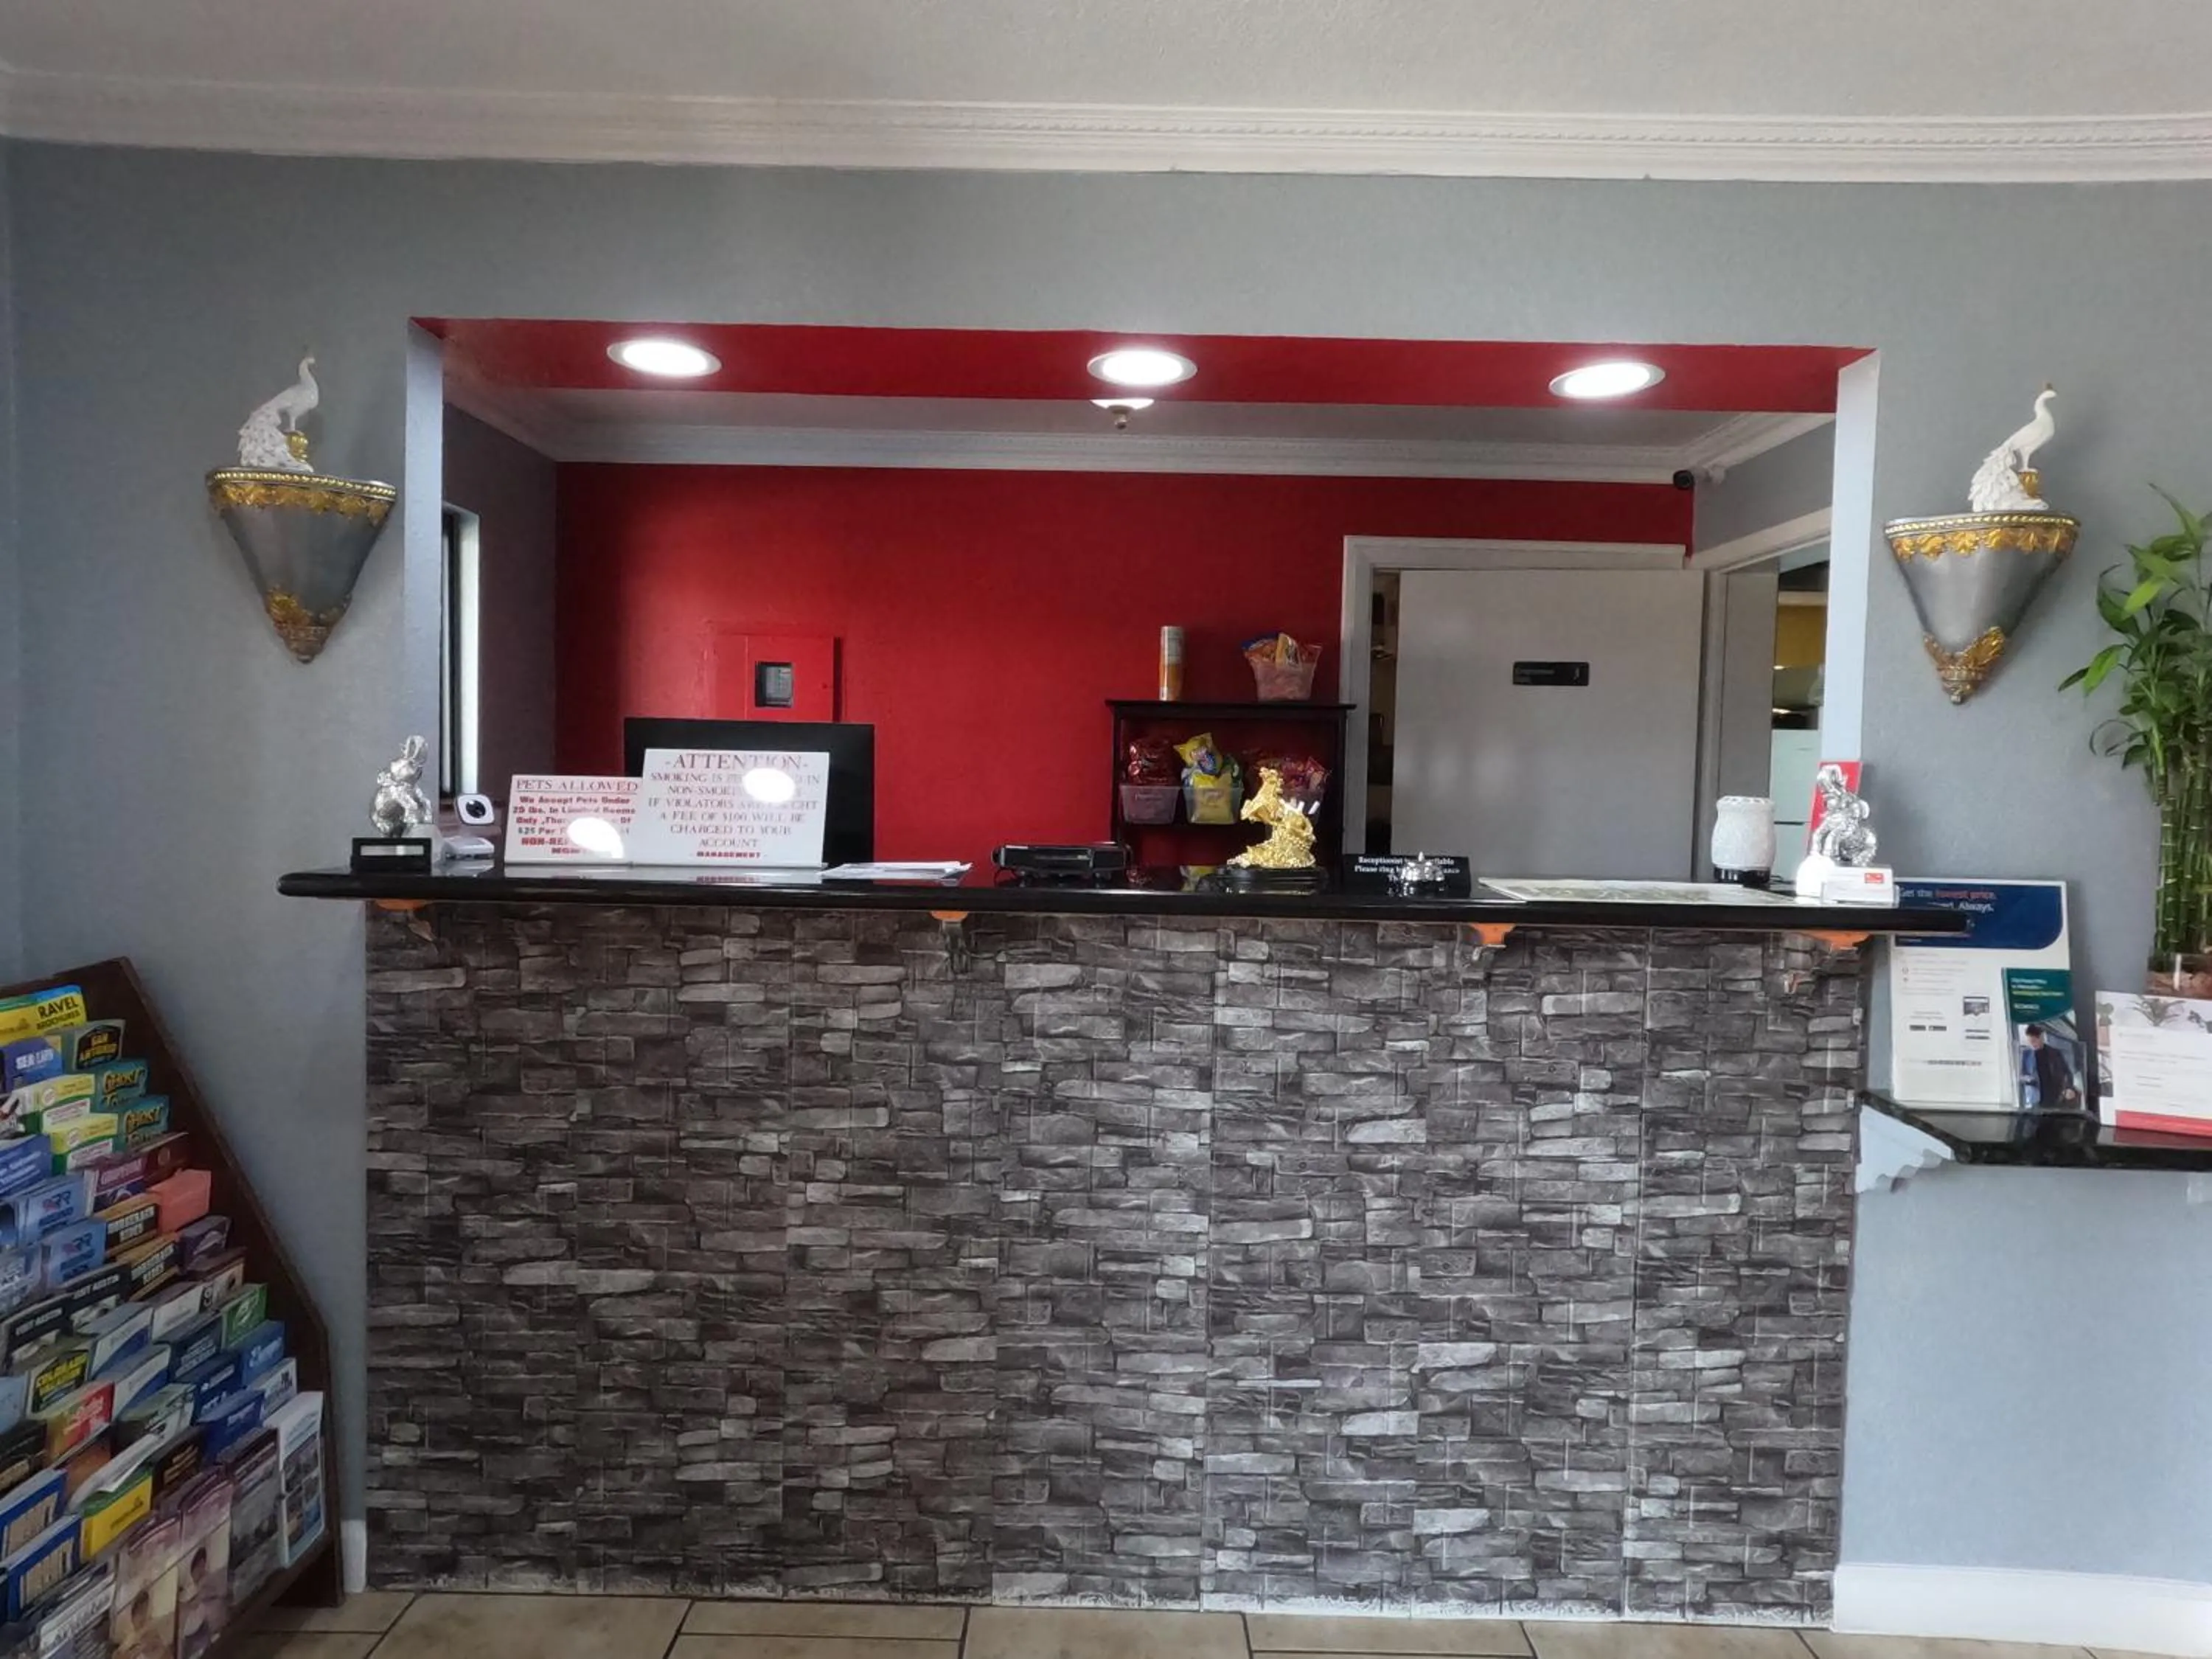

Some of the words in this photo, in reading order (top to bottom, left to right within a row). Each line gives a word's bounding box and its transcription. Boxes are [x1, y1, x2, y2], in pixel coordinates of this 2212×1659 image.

[651, 773, 706, 782] SMOKING
[712, 773, 723, 782] IS
[517, 779, 552, 790] PETS
[559, 780, 638, 791] ALLOWED
[539, 796, 572, 804] Accept
[602, 796, 630, 804] Under
[649, 797, 660, 807] IF
[667, 798, 734, 809] VIOLATORS
[516, 816, 537, 825] Only
[672, 812, 695, 821] FEE
[701, 813, 714, 821] OF
[752, 813, 782, 821] WILL
[791, 814, 804, 822] BE
[670, 824, 732, 834] CHARGED
[739, 825, 754, 834] TO
[761, 825, 791, 835] YOUR
[700, 838, 758, 847] ACCOUNT
[1358, 856, 1402, 865] Receptionist
[1354, 865, 1377, 873] Please
[1379, 866, 1394, 874] ring
[38, 995, 78, 1019] RAVEL
